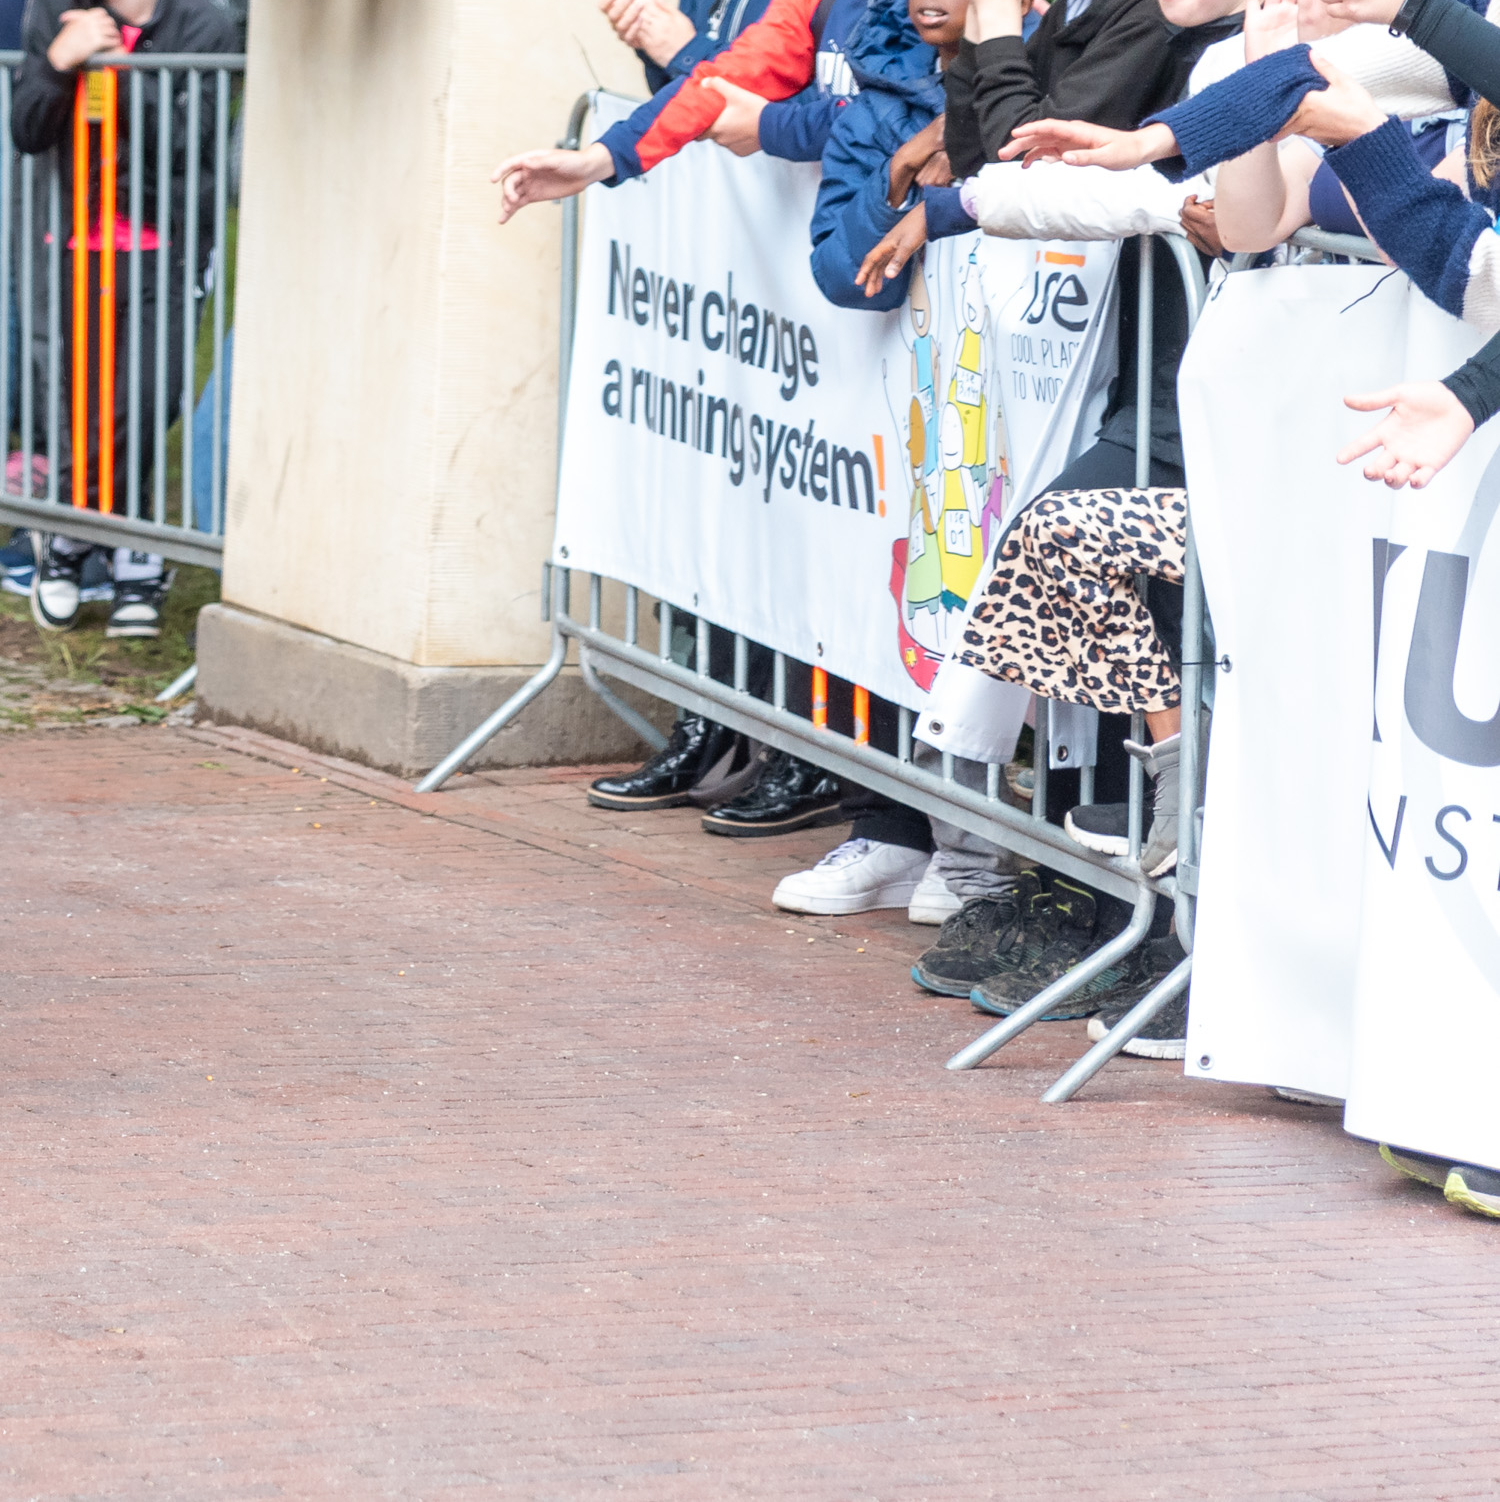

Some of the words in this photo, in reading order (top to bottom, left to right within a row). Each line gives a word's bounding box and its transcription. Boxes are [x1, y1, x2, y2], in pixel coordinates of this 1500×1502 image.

[607, 239, 695, 341] Never
[701, 271, 819, 401] change
[1011, 333, 1038, 366] COOL
[602, 359, 623, 418] a
[629, 367, 745, 486] running
